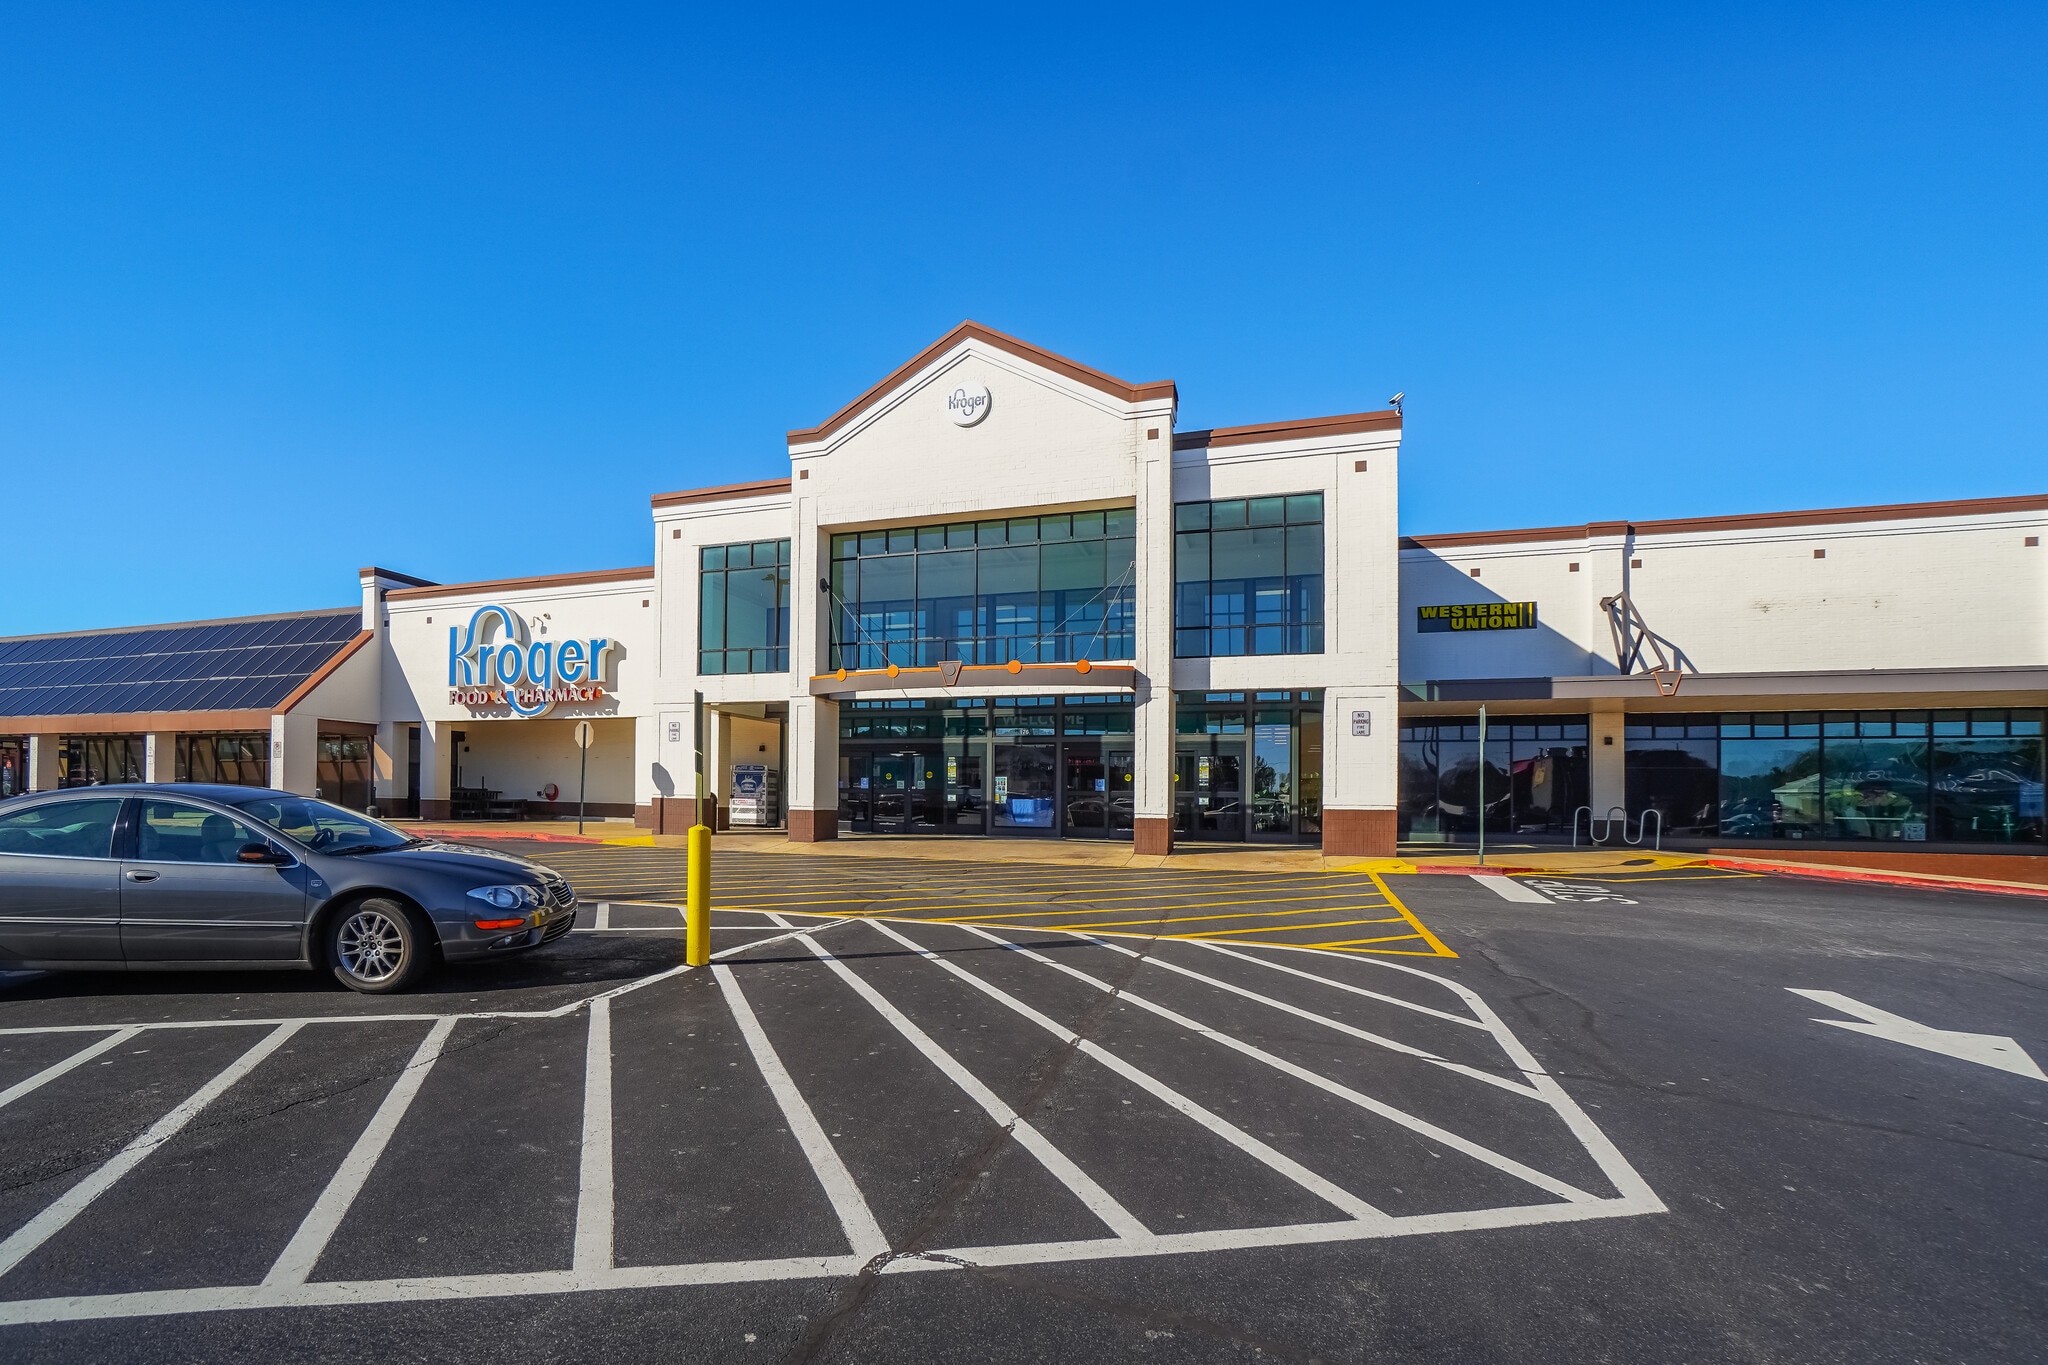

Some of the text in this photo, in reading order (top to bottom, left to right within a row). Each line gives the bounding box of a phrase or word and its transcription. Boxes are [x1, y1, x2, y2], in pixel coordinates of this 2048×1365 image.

[948, 388, 986, 417] Kroger
[1421, 603, 1517, 618] WESTERN
[1451, 615, 1517, 630] UNION
[449, 604, 610, 717] Kroger
[449, 686, 595, 705] FOOD & PHARMACY
